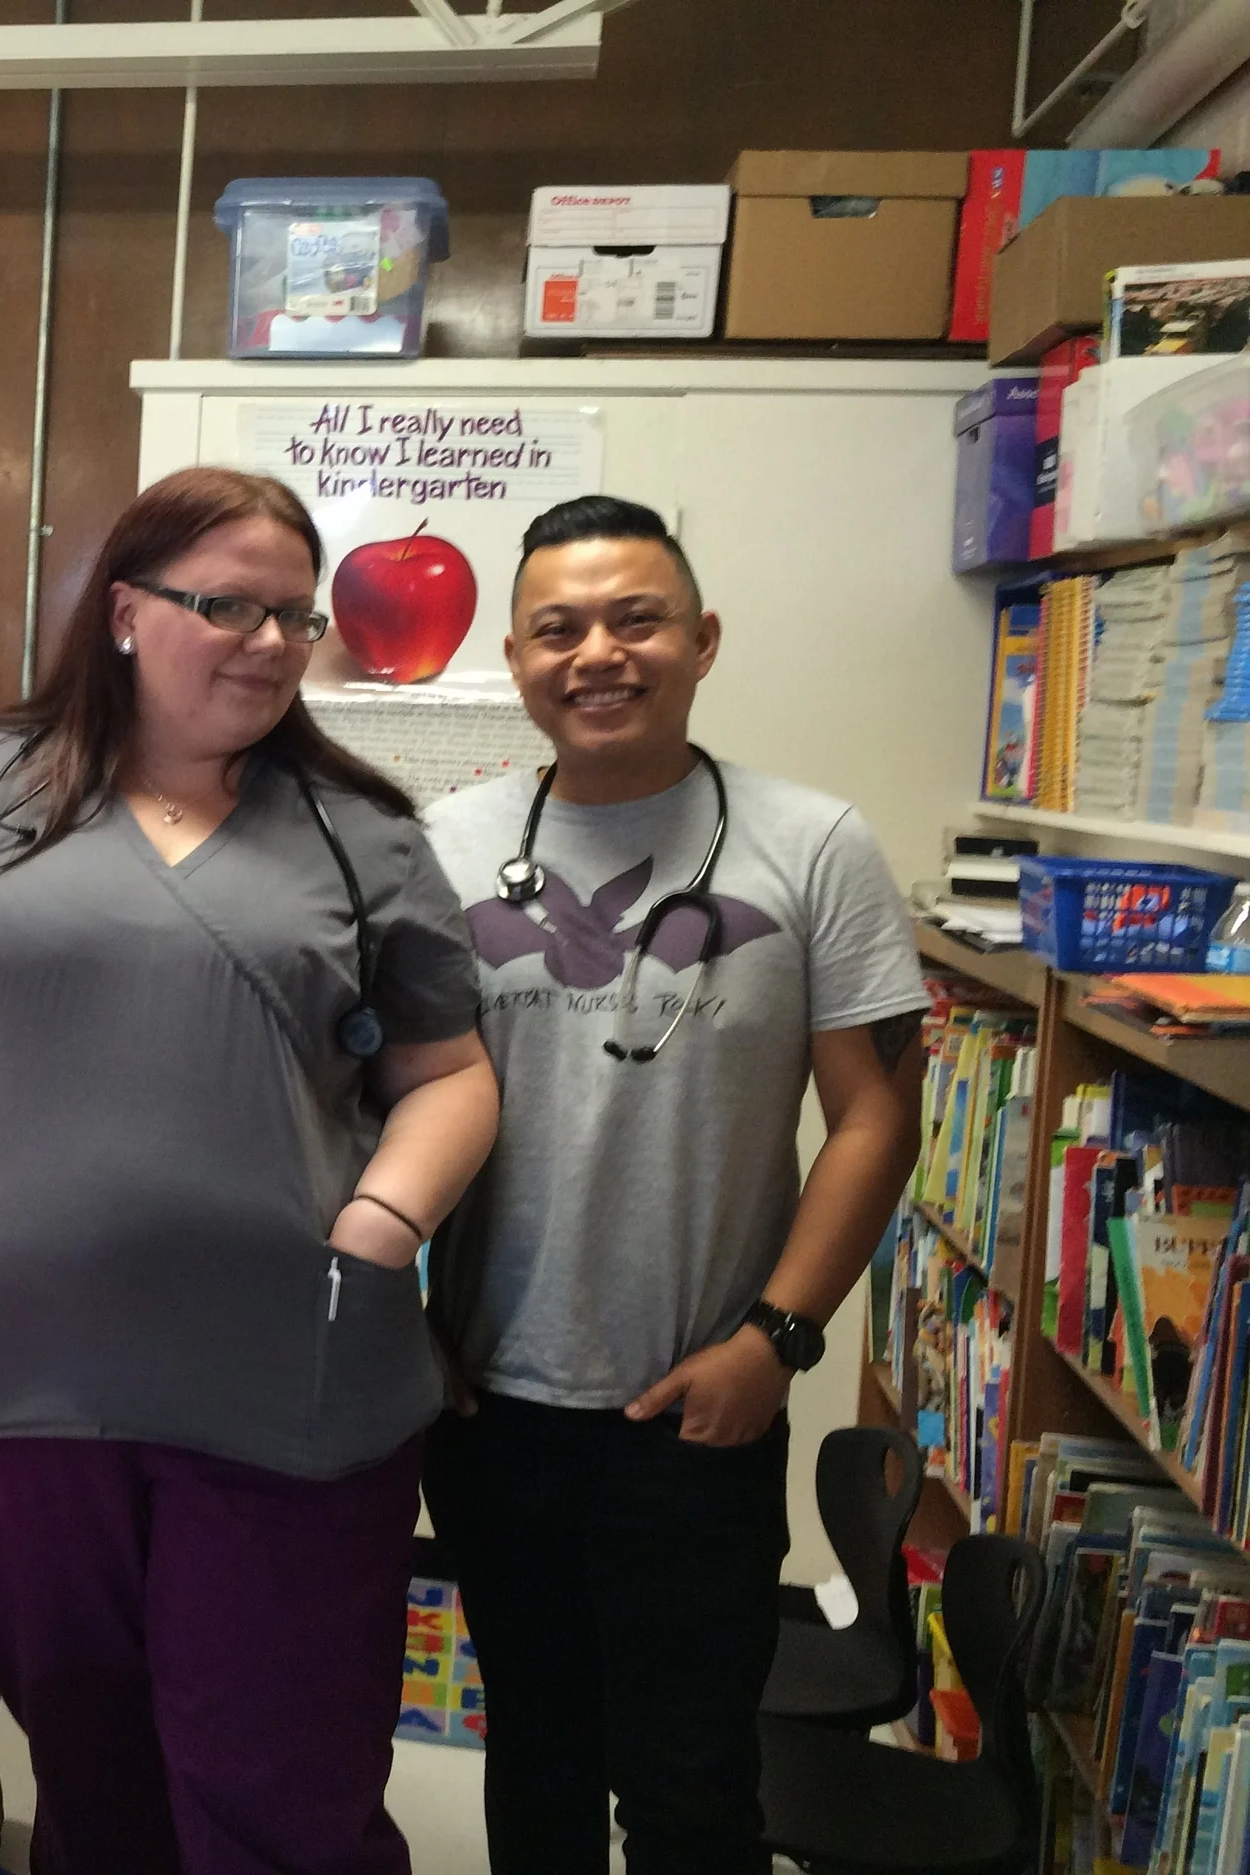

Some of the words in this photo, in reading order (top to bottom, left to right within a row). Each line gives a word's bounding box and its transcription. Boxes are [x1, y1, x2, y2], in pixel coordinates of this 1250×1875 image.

[310, 404, 350, 435] All
[357, 405, 374, 435] I
[379, 404, 455, 442] really
[460, 408, 522, 436] need
[285, 437, 315, 466] to
[320, 440, 391, 467] know
[396, 437, 412, 467] I
[415, 440, 527, 469] learned
[529, 439, 553, 468] in
